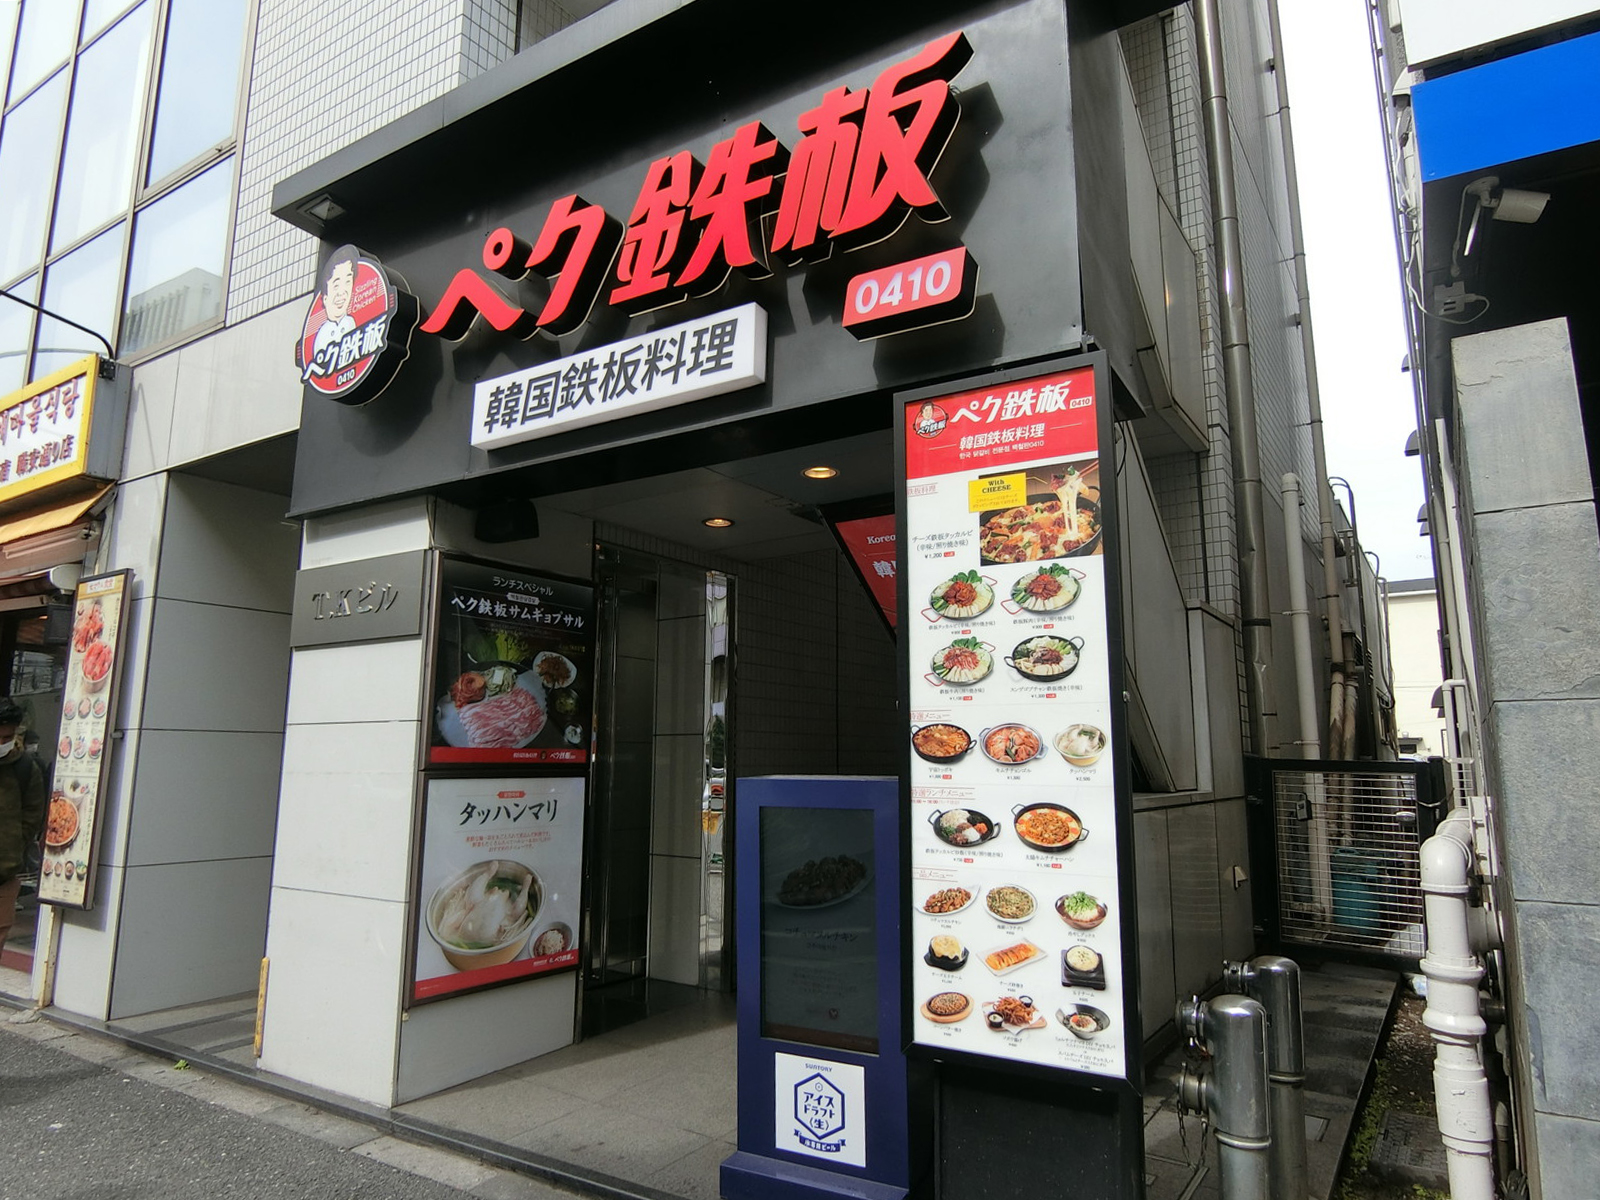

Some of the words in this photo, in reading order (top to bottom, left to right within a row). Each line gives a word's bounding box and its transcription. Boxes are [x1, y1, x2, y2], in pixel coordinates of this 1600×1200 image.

[420, 31, 968, 333] ペク鉄板
[355, 277, 378, 293] Sizzling
[854, 263, 952, 314] 0410
[353, 286, 377, 304] Korean
[352, 296, 377, 313] Chicken
[302, 314, 388, 381] ペク鉄板
[337, 368, 355, 386] 0410
[483, 318, 735, 434] 韓国鉄板料理
[950, 380, 1072, 424] ペク鉄板
[1071, 398, 1090, 408] 0410
[959, 422, 1046, 451] 韓国鉄板料理
[982, 484, 1011, 494] CHEESE
[988, 479, 1005, 487] With
[872, 560, 896, 578] 韓
[492, 575, 554, 596] ランチスペシャル
[451, 594, 585, 629] ペク鉄板サムギョプサル
[459, 799, 558, 827] タッハンマリ
[805, 1063, 833, 1072] SUNTORY
[803, 1091, 835, 1108] アイス
[804, 1103, 836, 1119] ドラフト
